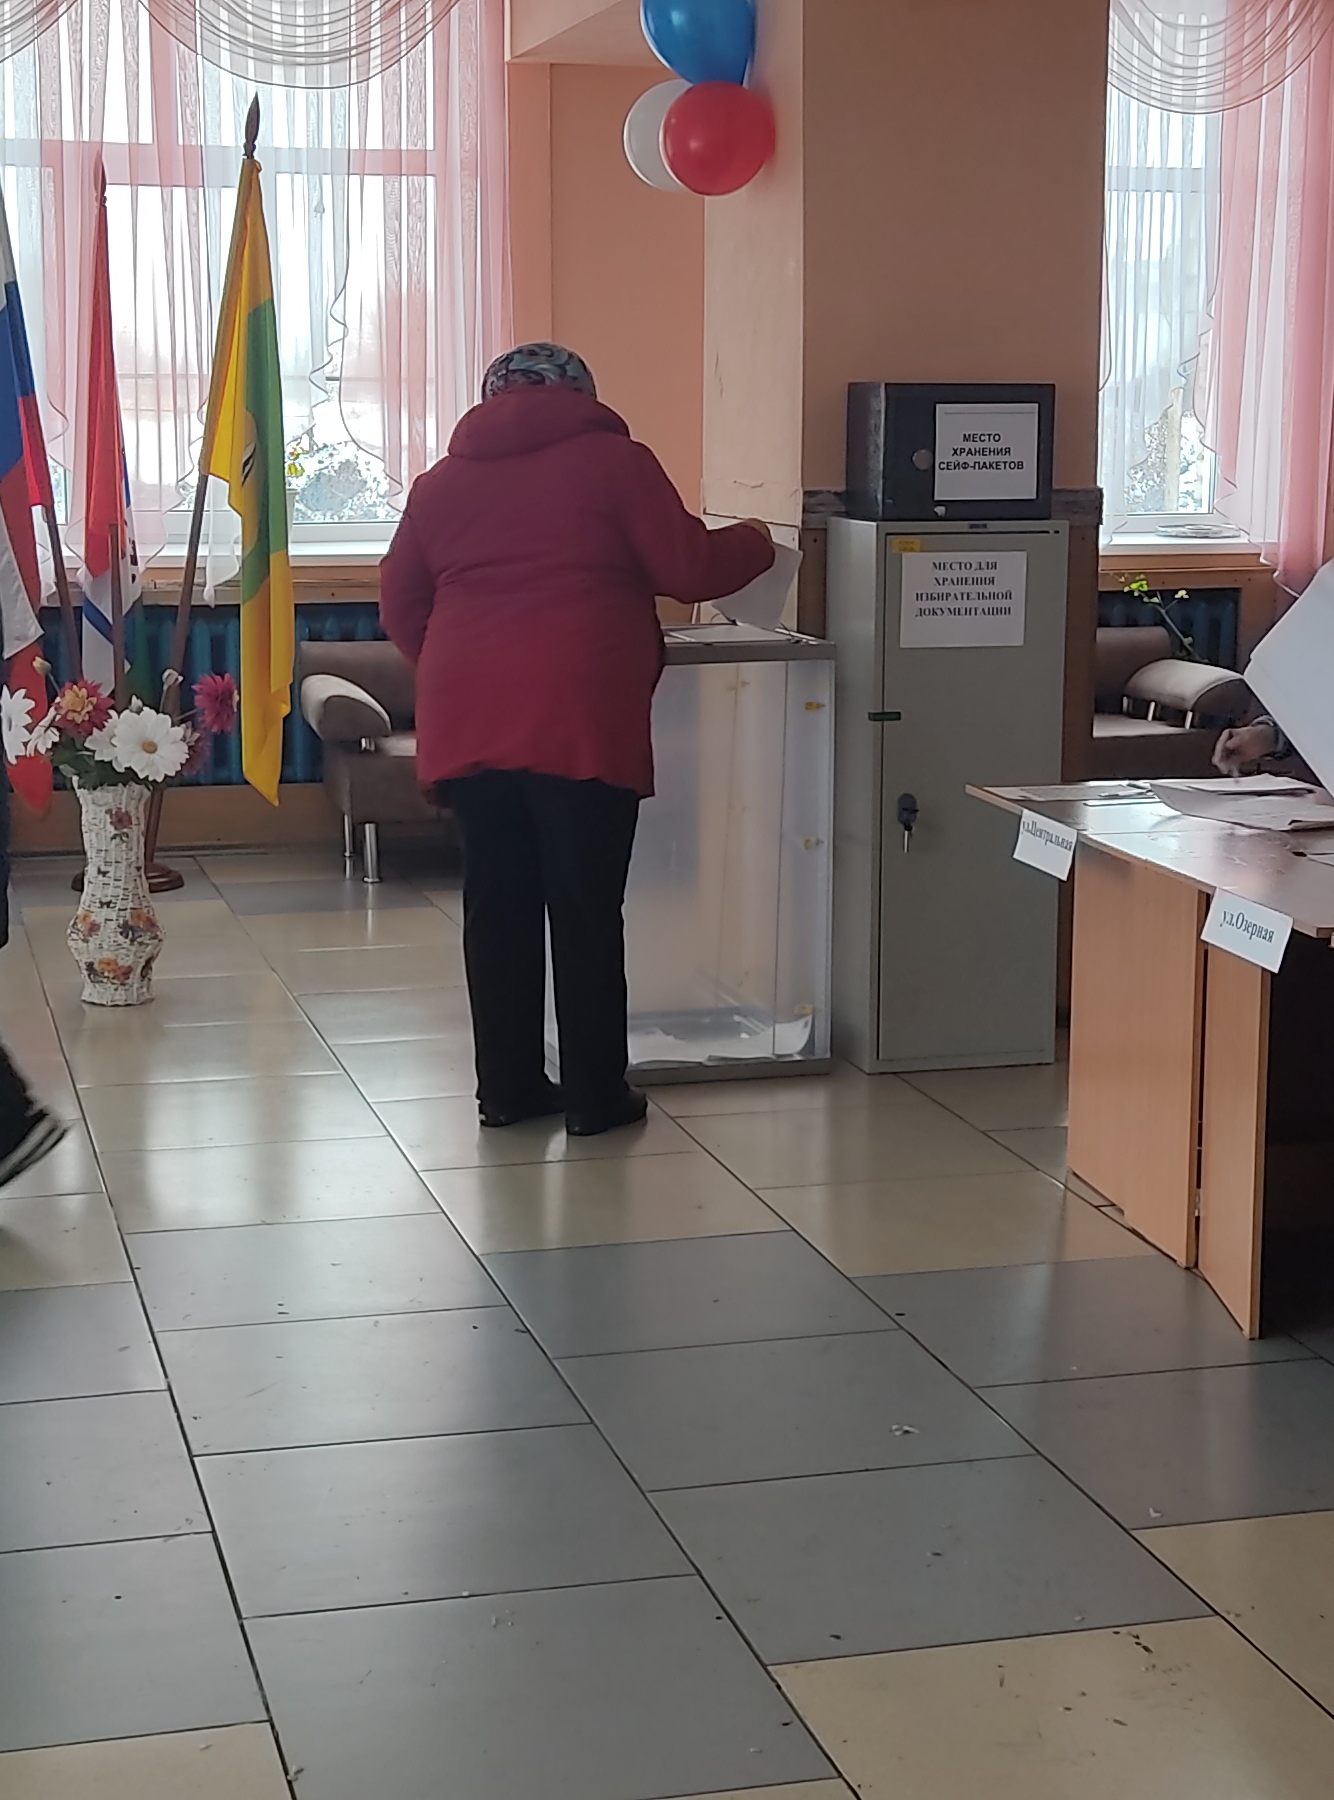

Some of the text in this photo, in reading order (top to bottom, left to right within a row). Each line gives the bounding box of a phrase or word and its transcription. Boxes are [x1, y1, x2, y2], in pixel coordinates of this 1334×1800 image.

[962, 433, 1002, 443] МЕСТО
[951, 447, 1011, 457] ХРАНЕНИЯ
[938, 460, 1025, 471] СЕЙФ-ПАКЕТОВ
[932, 561, 998, 571] МЕСТО ДЛЯ
[933, 576, 995, 586] ХРАНЕНИЯ
[915, 589, 1013, 602] ИЗБИРАТЕЛЬНОЙ
[915, 606, 1012, 618] ДОКУМЕНТАЦИИ
[1219, 910, 1275, 943] ул.Озерная
